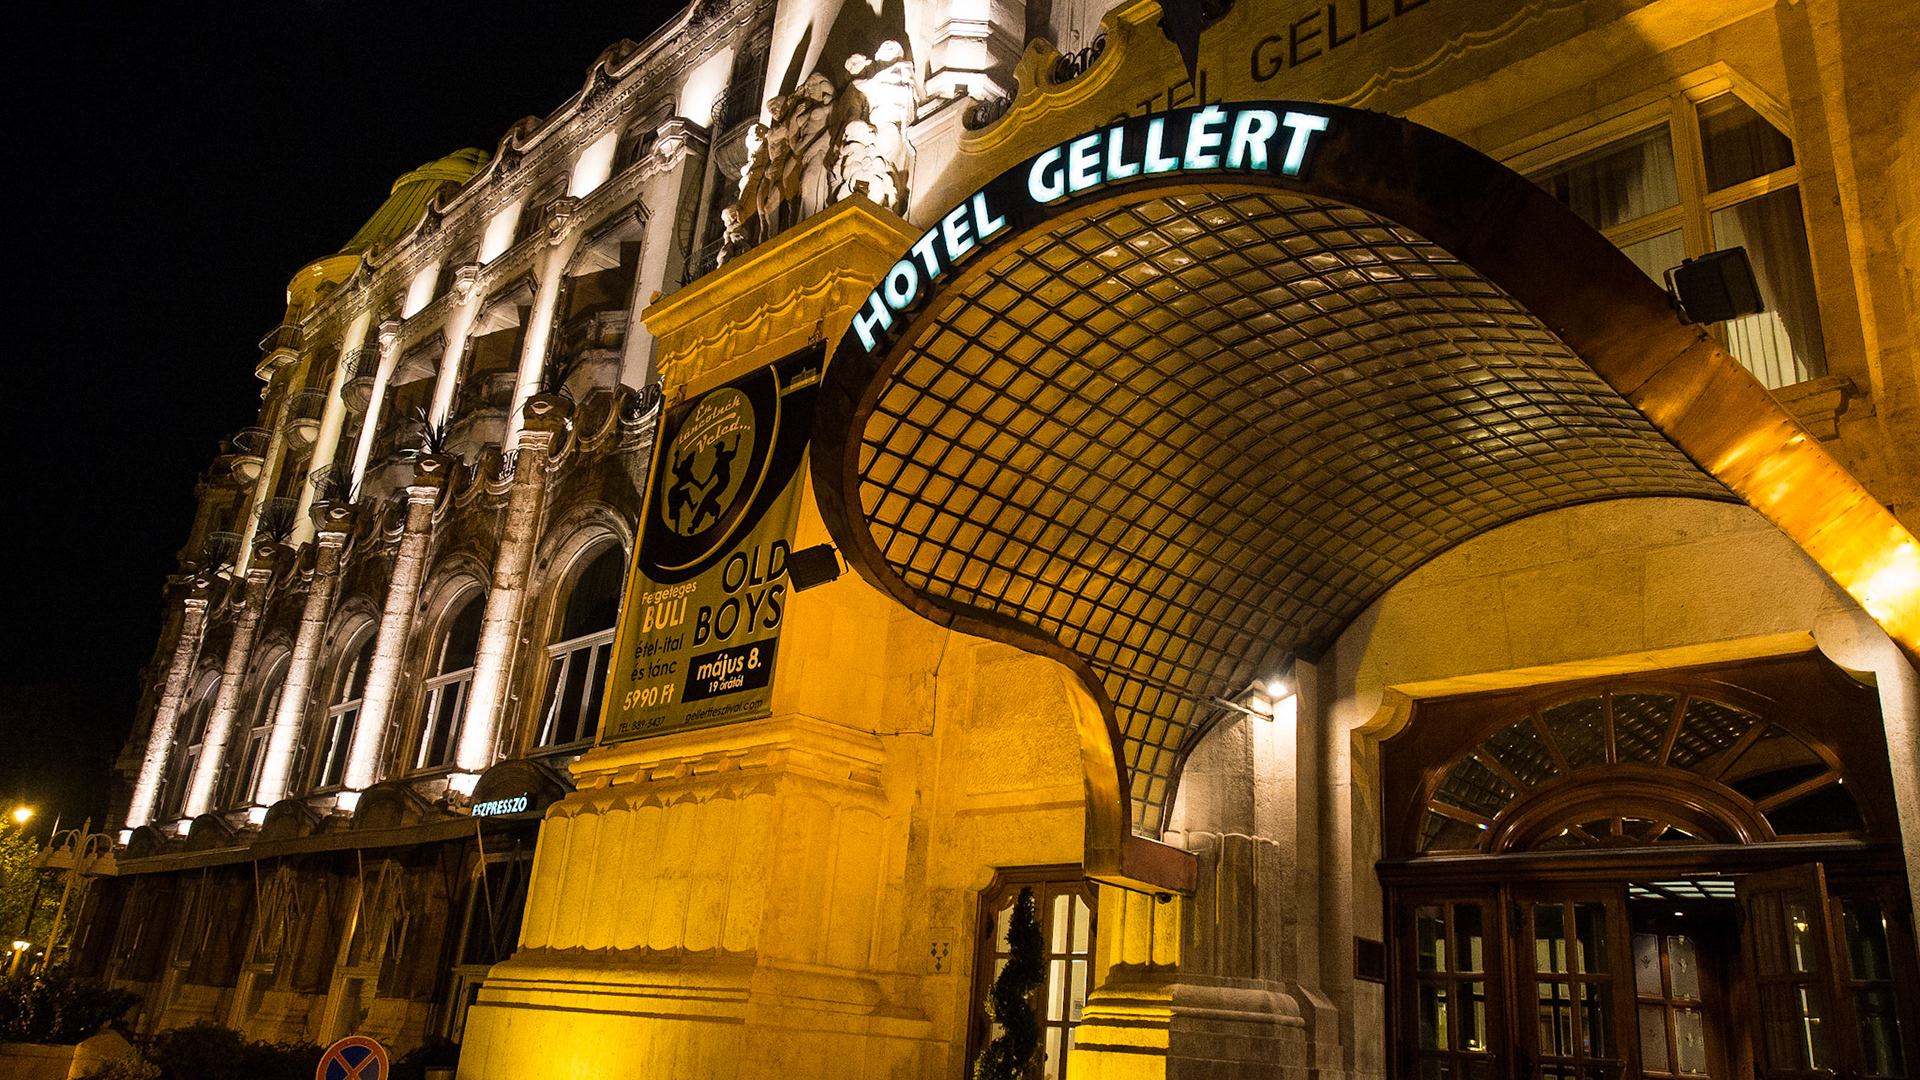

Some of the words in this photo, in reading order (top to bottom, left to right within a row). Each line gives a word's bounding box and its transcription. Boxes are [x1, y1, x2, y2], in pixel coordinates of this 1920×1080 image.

[1112, 70, 1223, 123] TEL
[853, 190, 1007, 354] HOTEL
[1027, 104, 1331, 204] GELLÉRT
[722, 539, 792, 595] OLD
[642, 597, 688, 634] BULI
[692, 584, 785, 648] BOYS
[635, 632, 685, 660] étel-ital
[631, 662, 645, 682] és
[648, 658, 678, 679] tánc
[696, 653, 745, 681] május
[747, 647, 762, 670] 8.
[622, 686, 659, 711] 5990
[660, 683, 675, 705] Ft
[708, 681, 719, 693] 19
[719, 675, 744, 690] órától
[471, 791, 528, 817] ESZPRESSZÓ
